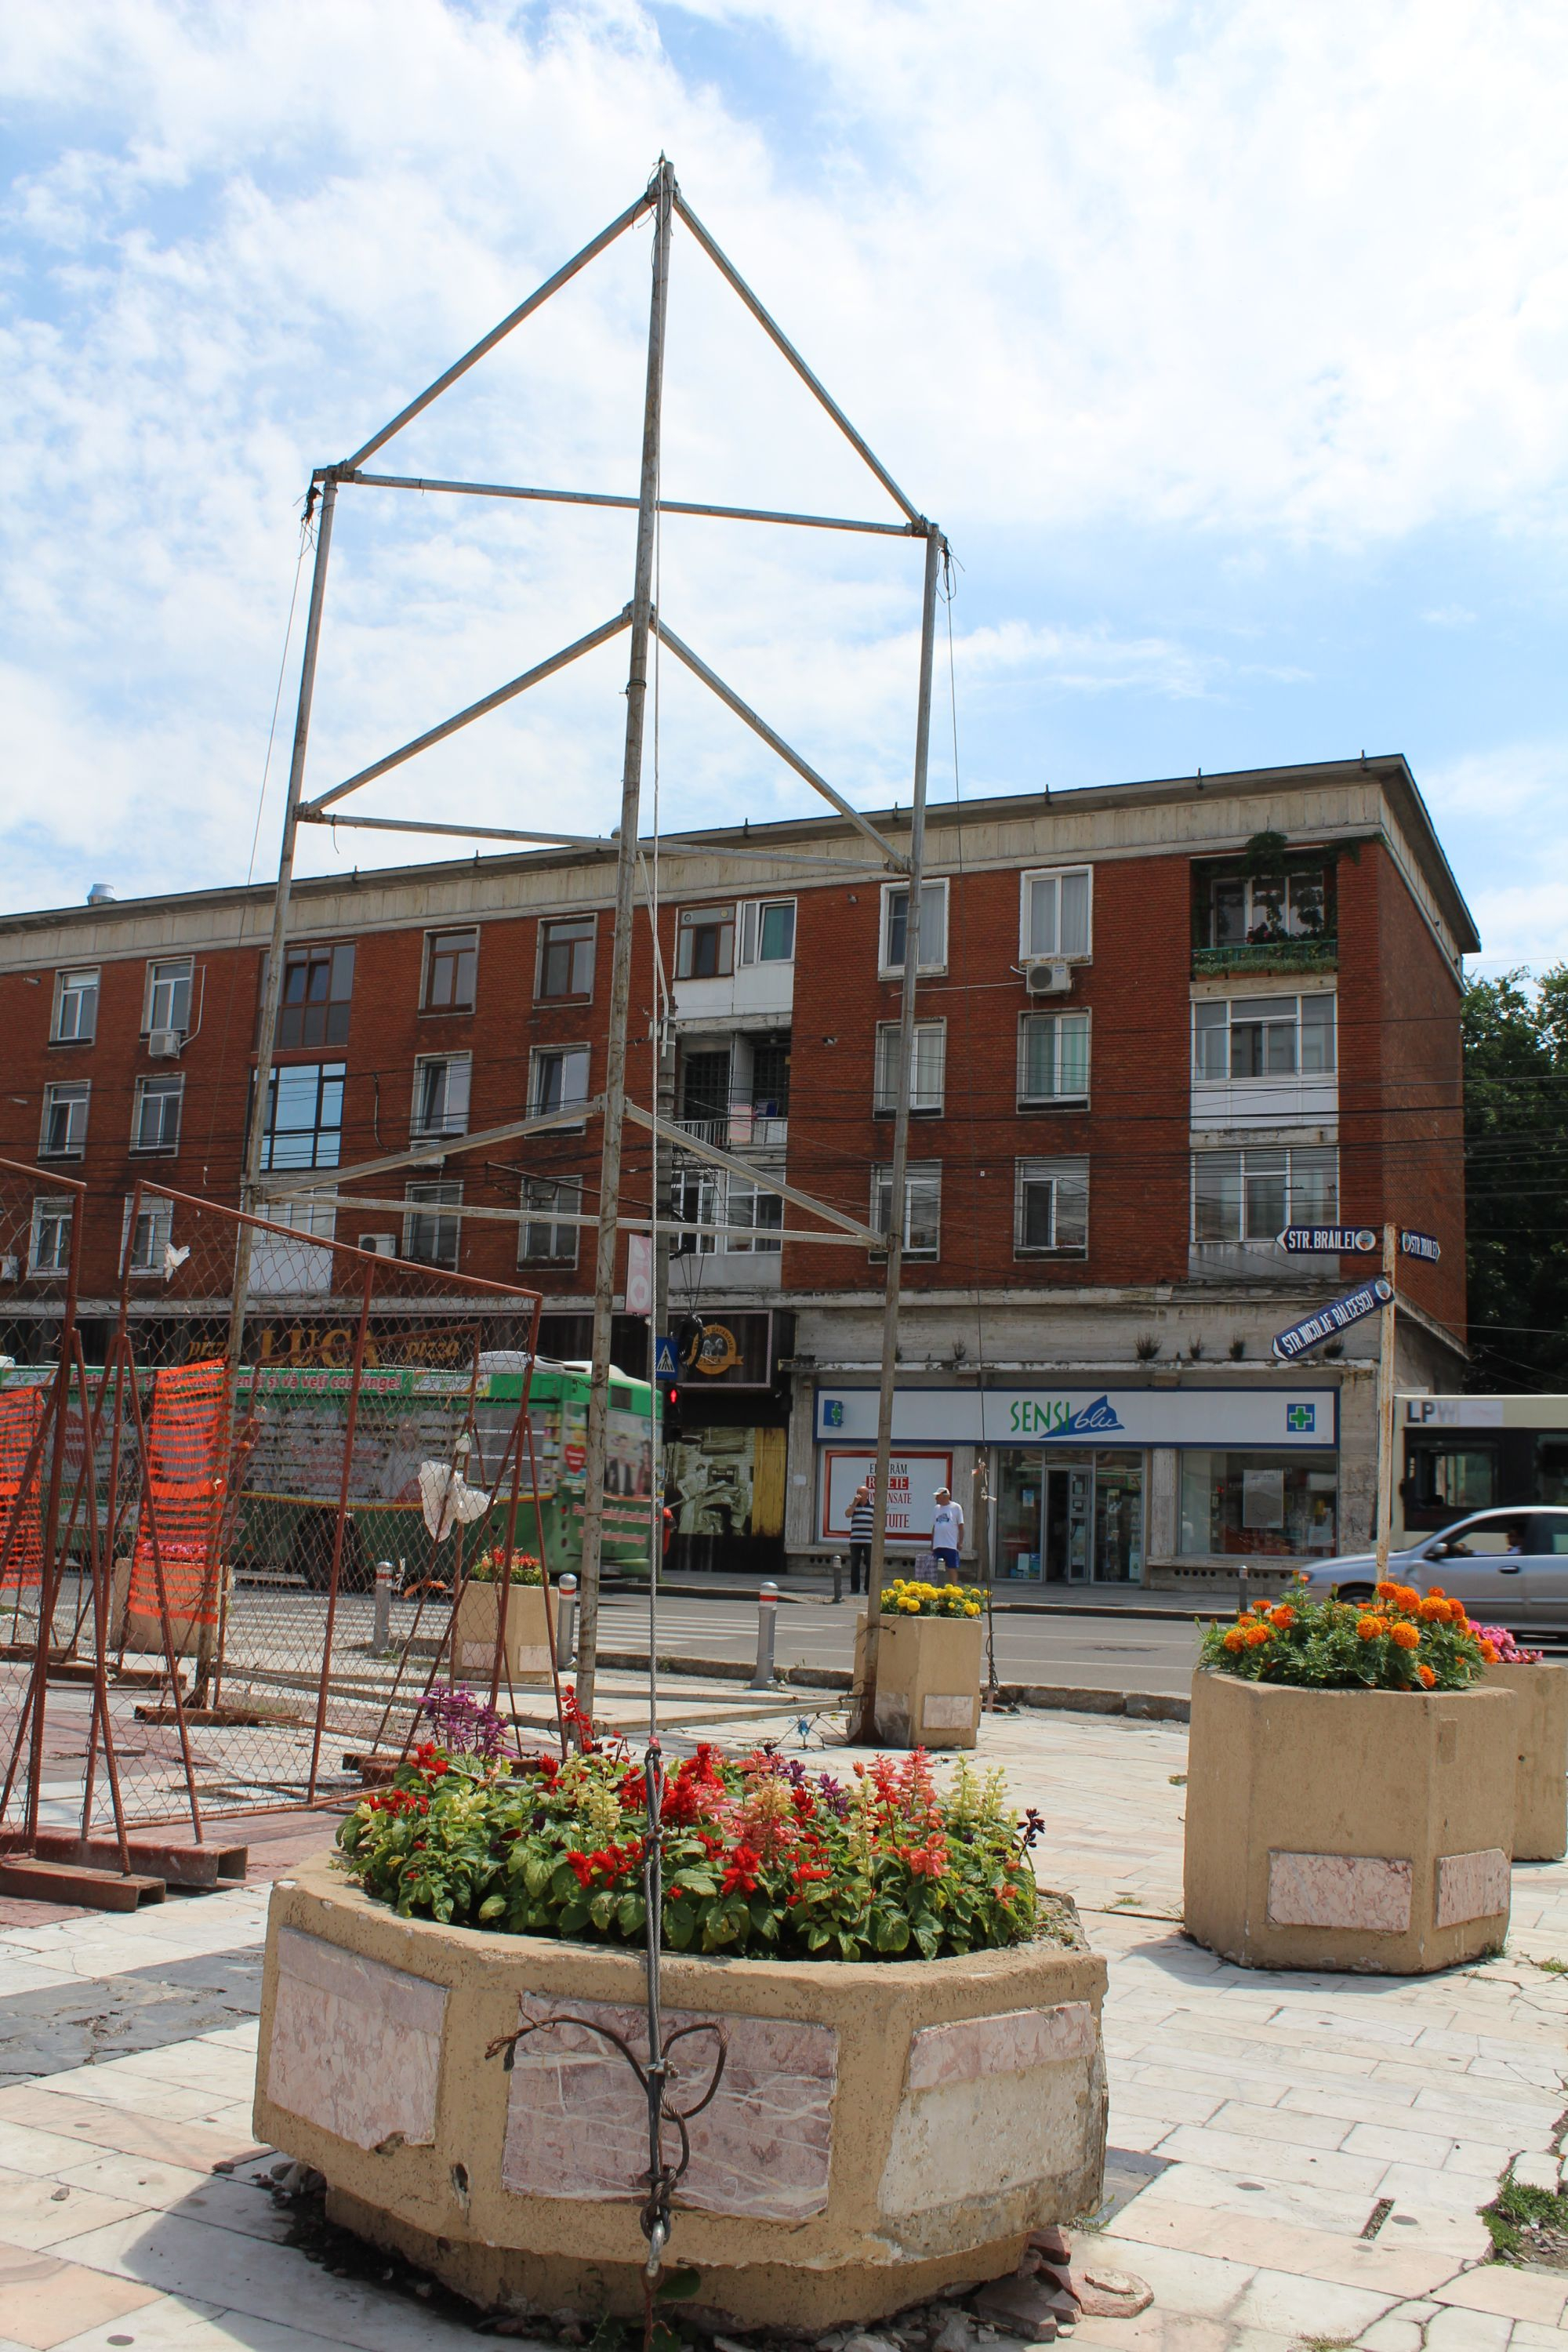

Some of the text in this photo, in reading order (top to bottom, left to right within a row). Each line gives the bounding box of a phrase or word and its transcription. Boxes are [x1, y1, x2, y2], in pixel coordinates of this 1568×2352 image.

[259, 1329, 381, 1368] LUCA
[401, 1335, 460, 1364] pizza
[1011, 1400, 1070, 1432] SENSI
[868, 1477, 907, 1489] RETE
